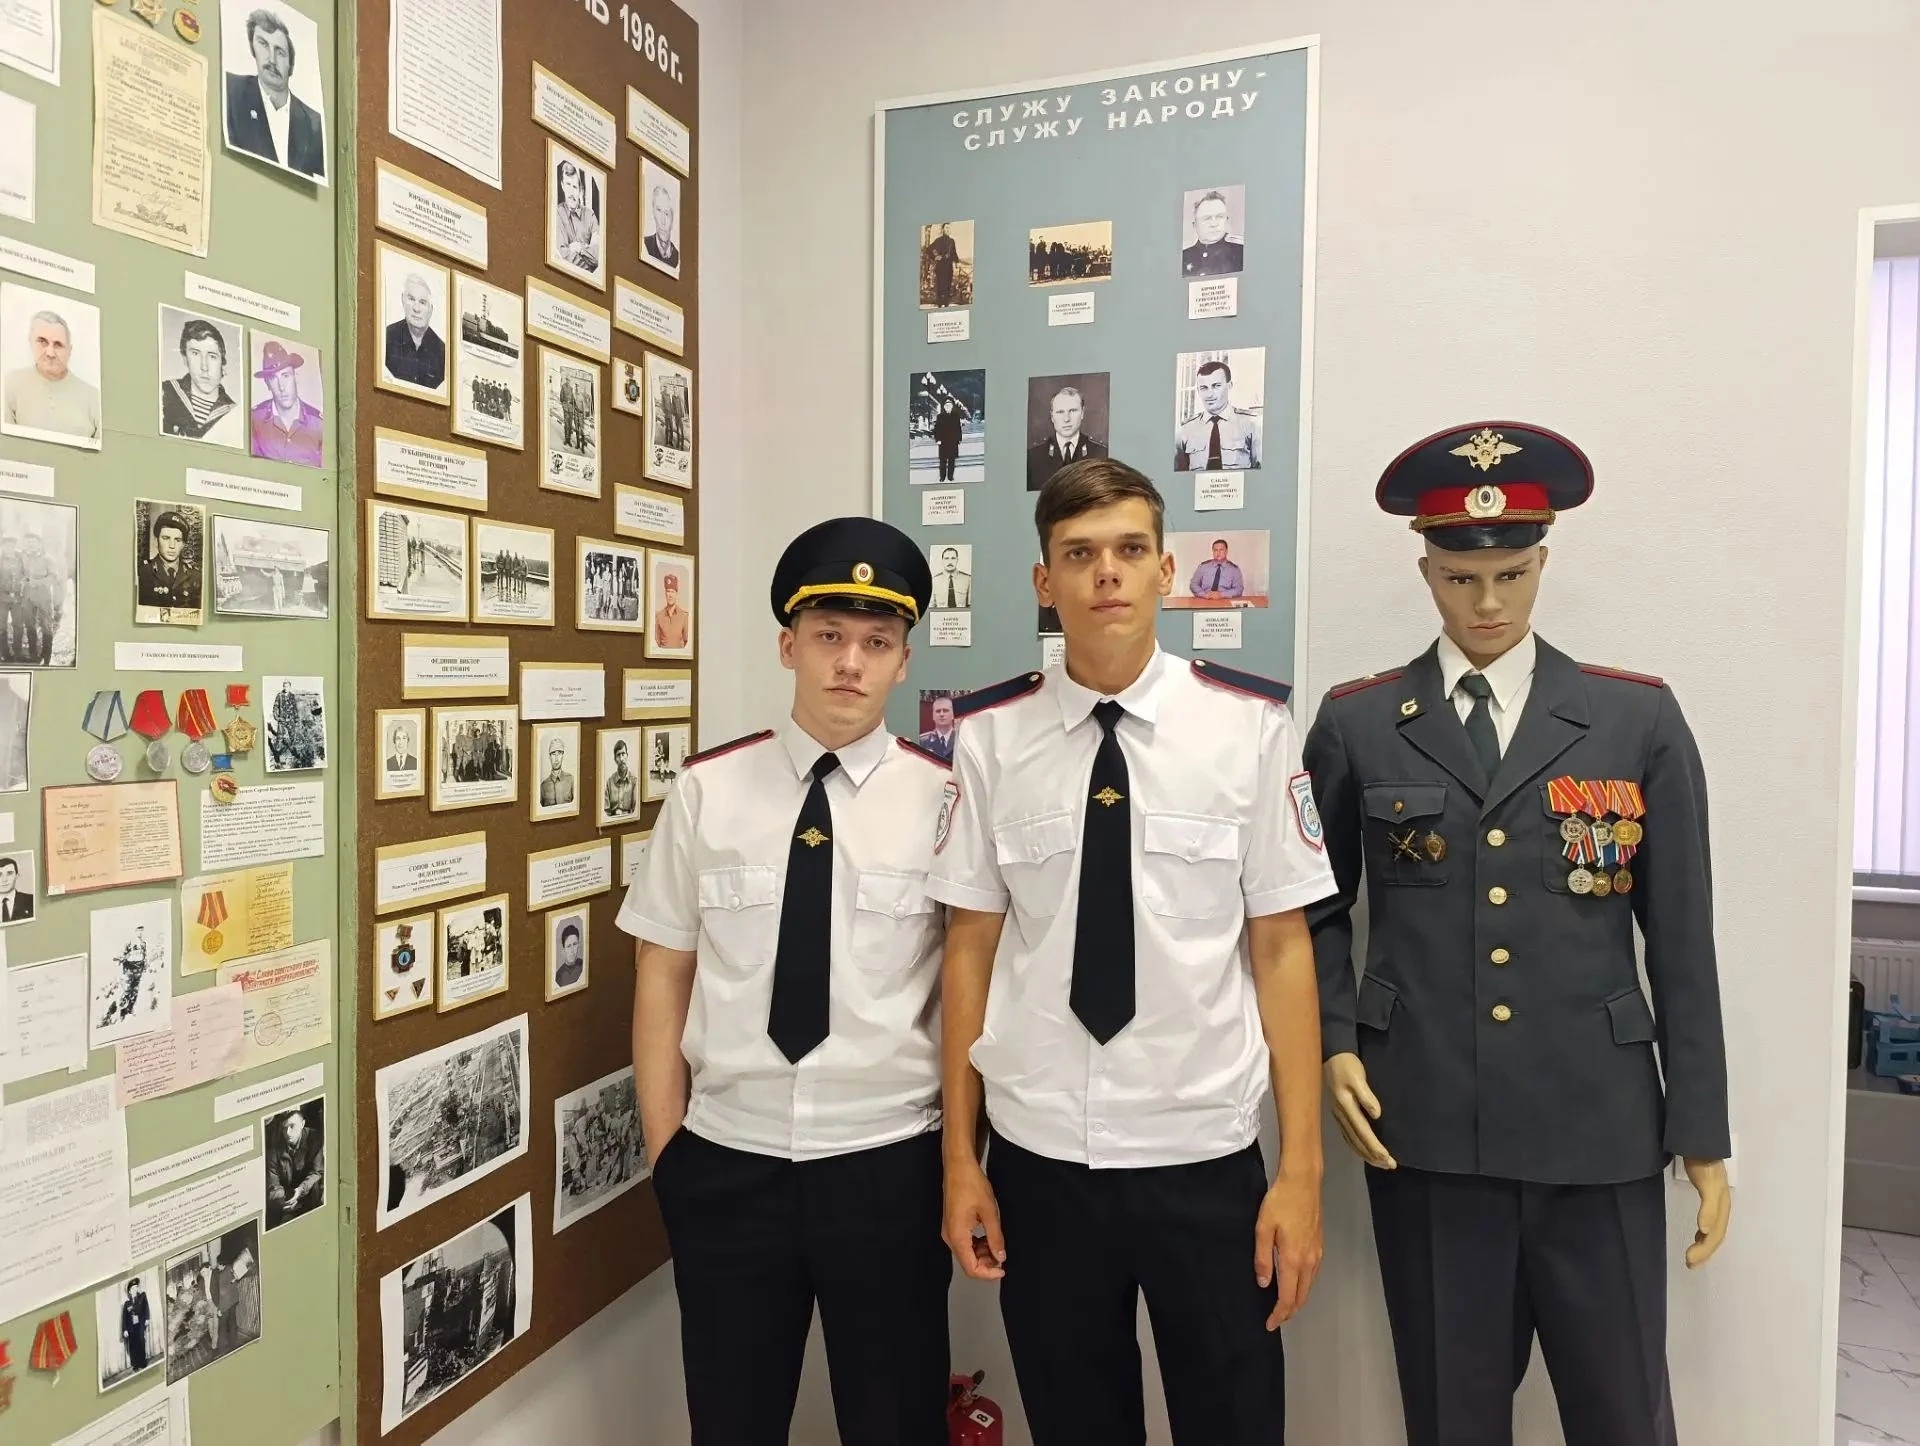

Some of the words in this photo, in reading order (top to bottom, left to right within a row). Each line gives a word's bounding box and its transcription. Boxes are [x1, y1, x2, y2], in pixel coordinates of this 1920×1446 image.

[620, 3, 683, 85] 1986г.
[953, 94, 1072, 128] СЛУЖУ
[964, 116, 1084, 151] СЛУЖУ
[1107, 91, 1258, 131] НАРОДУ
[976, 1413, 989, 1423] 8
